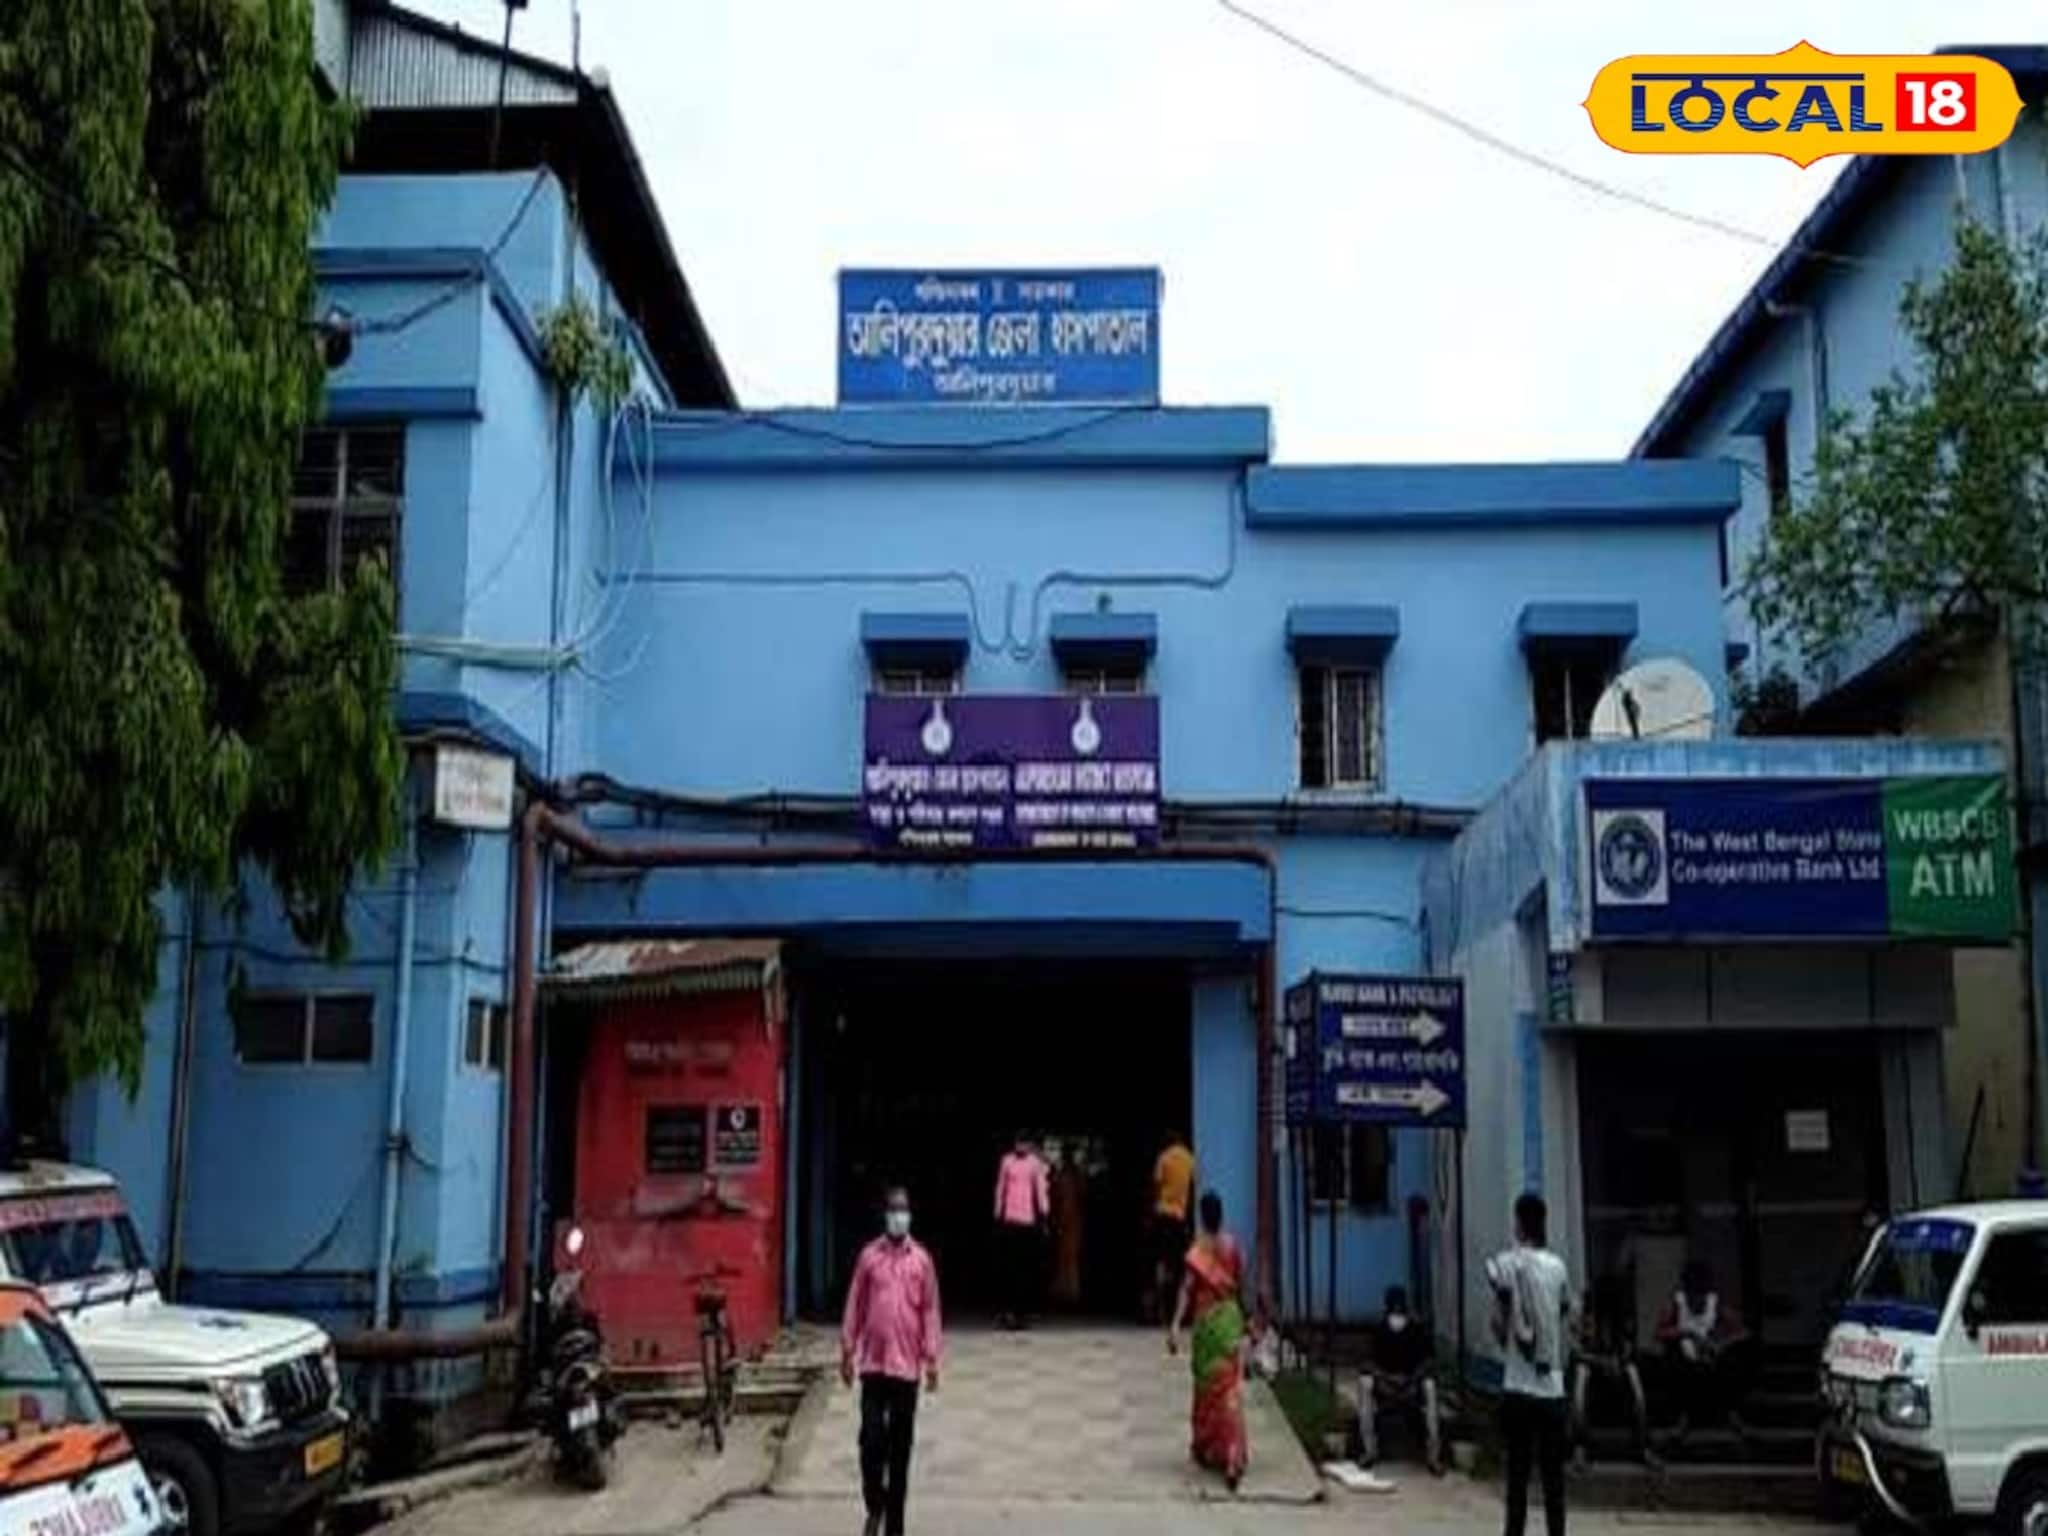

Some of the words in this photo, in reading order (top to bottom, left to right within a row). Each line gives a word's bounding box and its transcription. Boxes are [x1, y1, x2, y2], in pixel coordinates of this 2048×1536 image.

[1671, 831, 1707, 850] The
[1712, 831, 1758, 851] West
[1764, 829, 1831, 855] Bengal
[1795, 857, 1843, 880] Bank
[1848, 855, 1880, 880] Ltd
[1909, 850, 1995, 897] ATM
